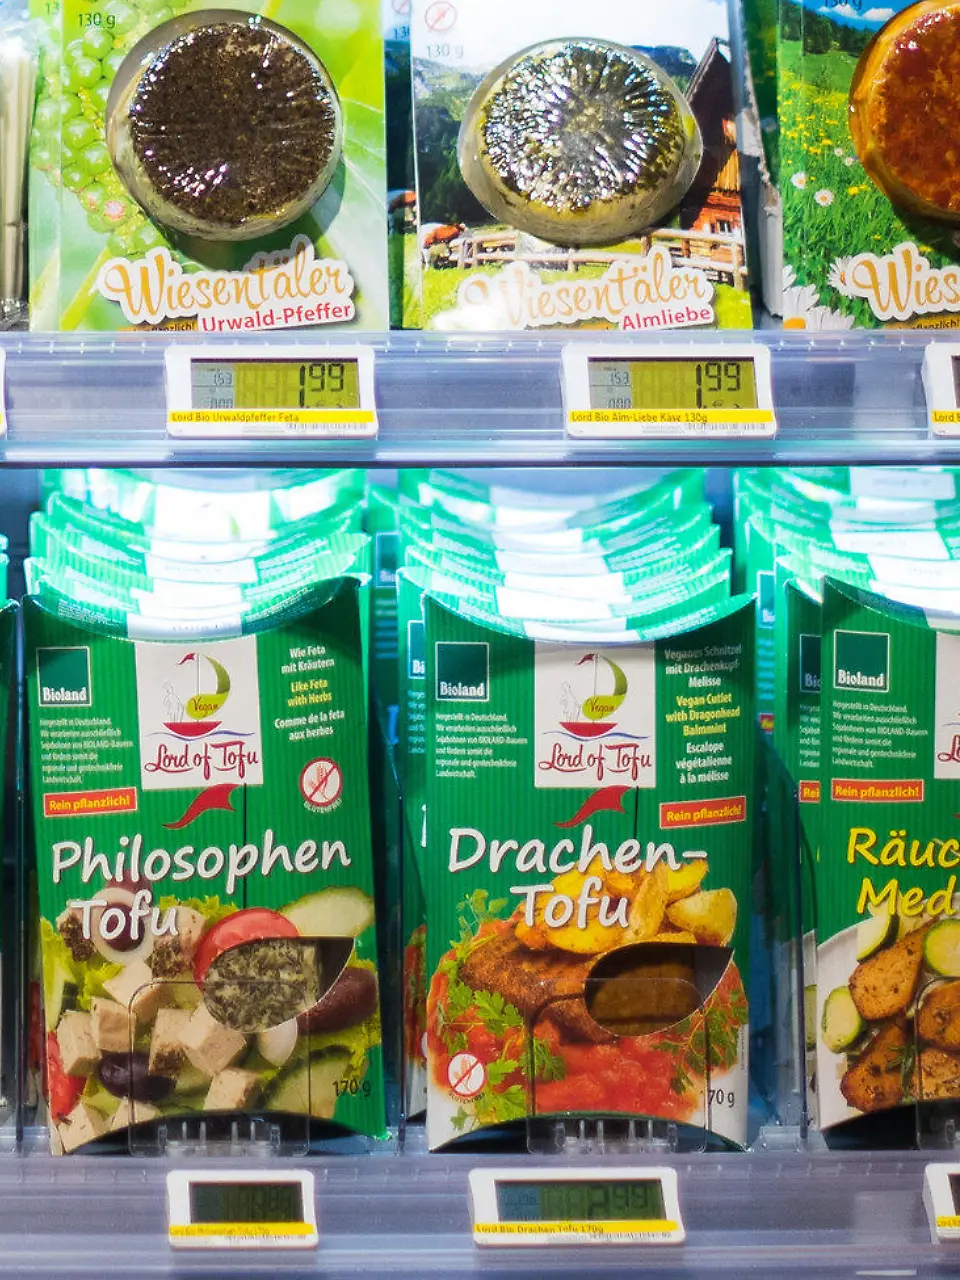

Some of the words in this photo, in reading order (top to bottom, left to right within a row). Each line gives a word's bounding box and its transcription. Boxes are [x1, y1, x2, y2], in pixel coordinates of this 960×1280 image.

[78, 13, 101, 28] 130
[105, 242, 346, 317] Wiesentäler
[202, 303, 352, 331] Urwald-Pfeffer
[622, 306, 711, 330] Almliebe
[289, 647, 306, 659] Wie
[307, 645, 326, 656] Feta
[281, 662, 297, 674] mit
[665, 663, 683, 675] mit
[688, 676, 722, 688] Melisse
[838, 669, 884, 686] Bioland
[43, 686, 87, 702] Bioland
[291, 681, 308, 693] Like
[310, 679, 328, 689] Feta
[440, 682, 484, 697] Bioland
[193, 697, 219, 713] Vegan
[287, 694, 307, 707] with
[308, 691, 332, 704] Herbs
[587, 697, 616, 713] Vegan
[676, 695, 705, 709] Vegan
[706, 692, 732, 705] Cutlet
[274, 716, 307, 729] Comme
[308, 712, 318, 724] de
[320, 711, 328, 722] la
[328, 709, 345, 721] feta
[665, 710, 688, 722] with
[689, 705, 740, 722] Dragonhead
[289, 730, 305, 741] aux
[306, 725, 334, 738] herbes
[686, 741, 724, 754] Escalope
[144, 743, 192, 773] Lord
[193, 744, 211, 780] of
[210, 741, 259, 780] Tofu
[538, 742, 584, 773] Lord
[587, 743, 605, 781] of
[605, 742, 651, 780] Tofu
[675, 756, 732, 771] végétalienne
[687, 772, 697, 783] la
[835, 785, 859, 797] Rein
[860, 785, 919, 799] pflanzlich!
[49, 800, 72, 811] Rein
[73, 795, 131, 812] pflanzlich!
[666, 810, 691, 823] Rein
[693, 804, 742, 822] pflanzlich!
[448, 824, 708, 872] Drachen-
[51, 828, 352, 895] Philosophen
[510, 876, 629, 930] Tofu
[856, 875, 958, 917] Med
[71, 889, 179, 940] Tofu
[333, 1080, 358, 1097] 170
[361, 1080, 371, 1097] g
[727, 1091, 735, 1107] g
